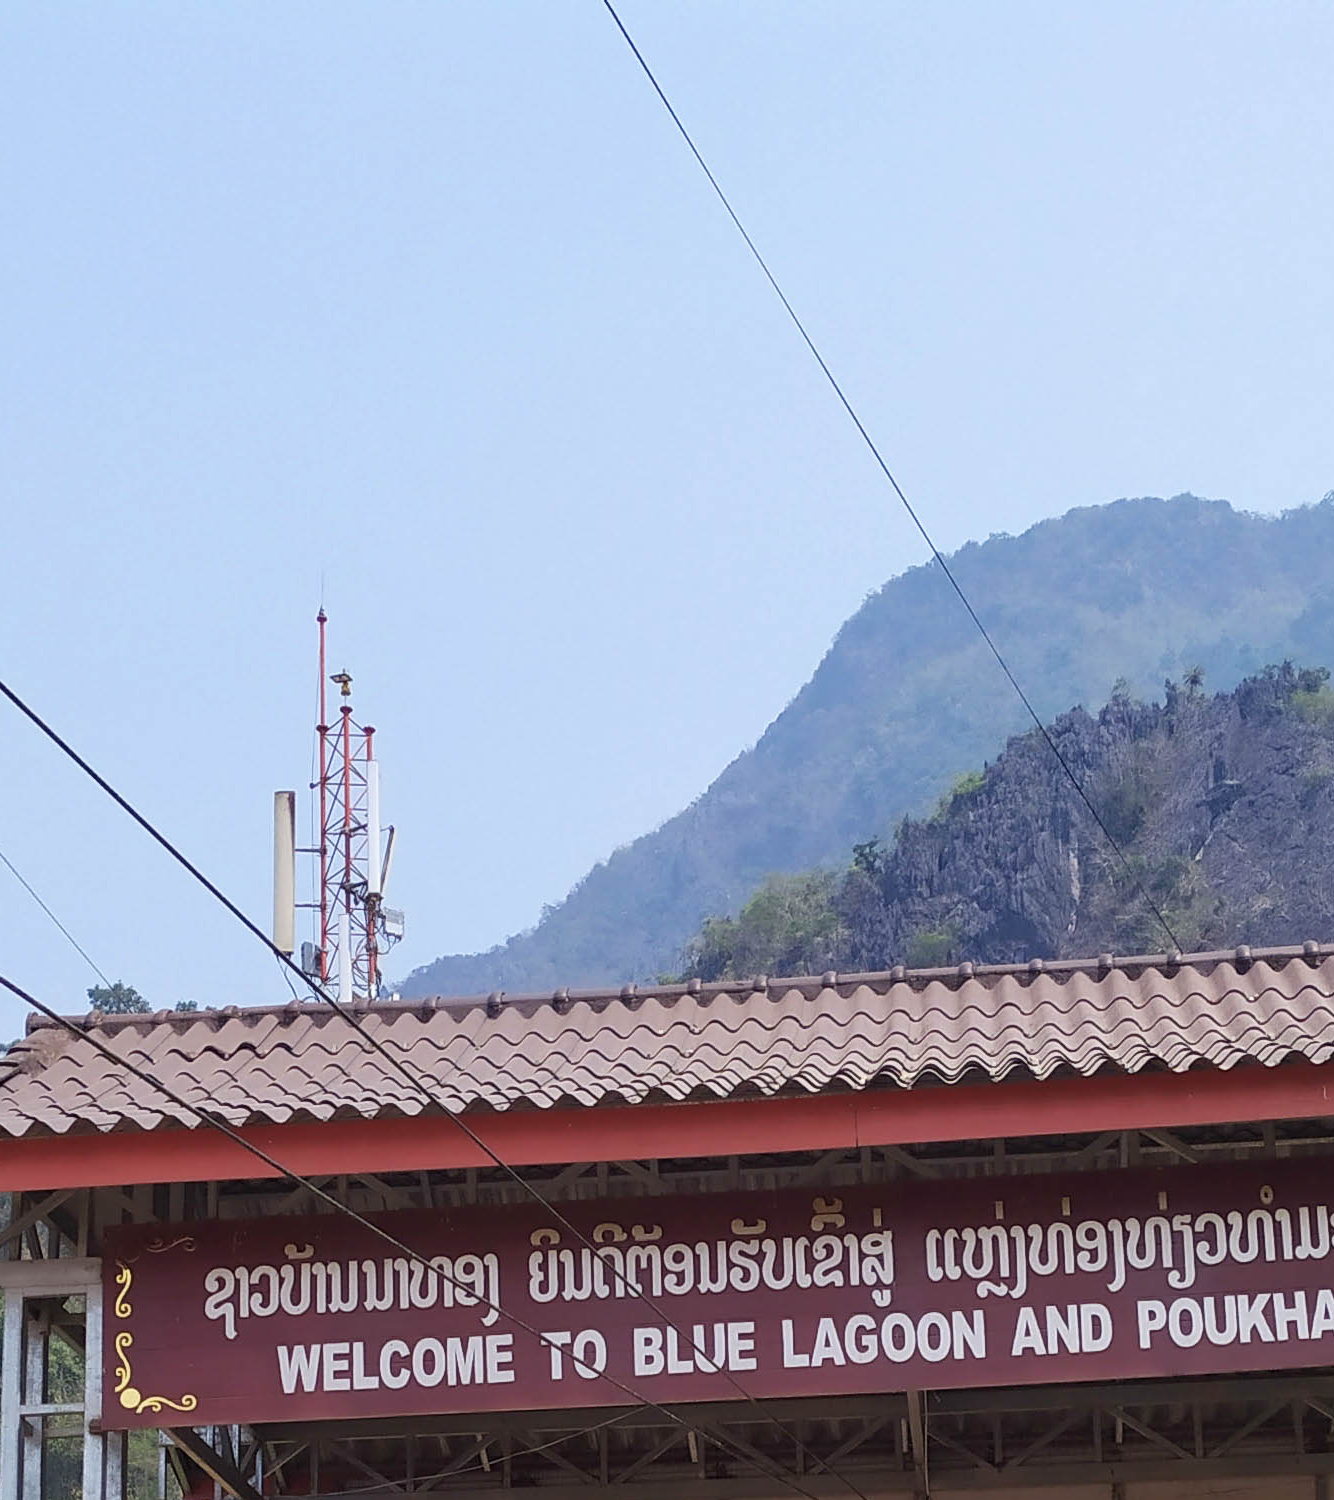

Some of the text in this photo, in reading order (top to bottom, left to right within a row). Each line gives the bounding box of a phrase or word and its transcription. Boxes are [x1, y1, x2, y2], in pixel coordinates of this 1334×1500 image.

[277, 1334, 515, 1394] WELCOME
[541, 1330, 607, 1380] TO
[634, 1321, 756, 1376] BLUE
[782, 1308, 985, 1368] LAGOON
[1011, 1303, 1113, 1356] AND
